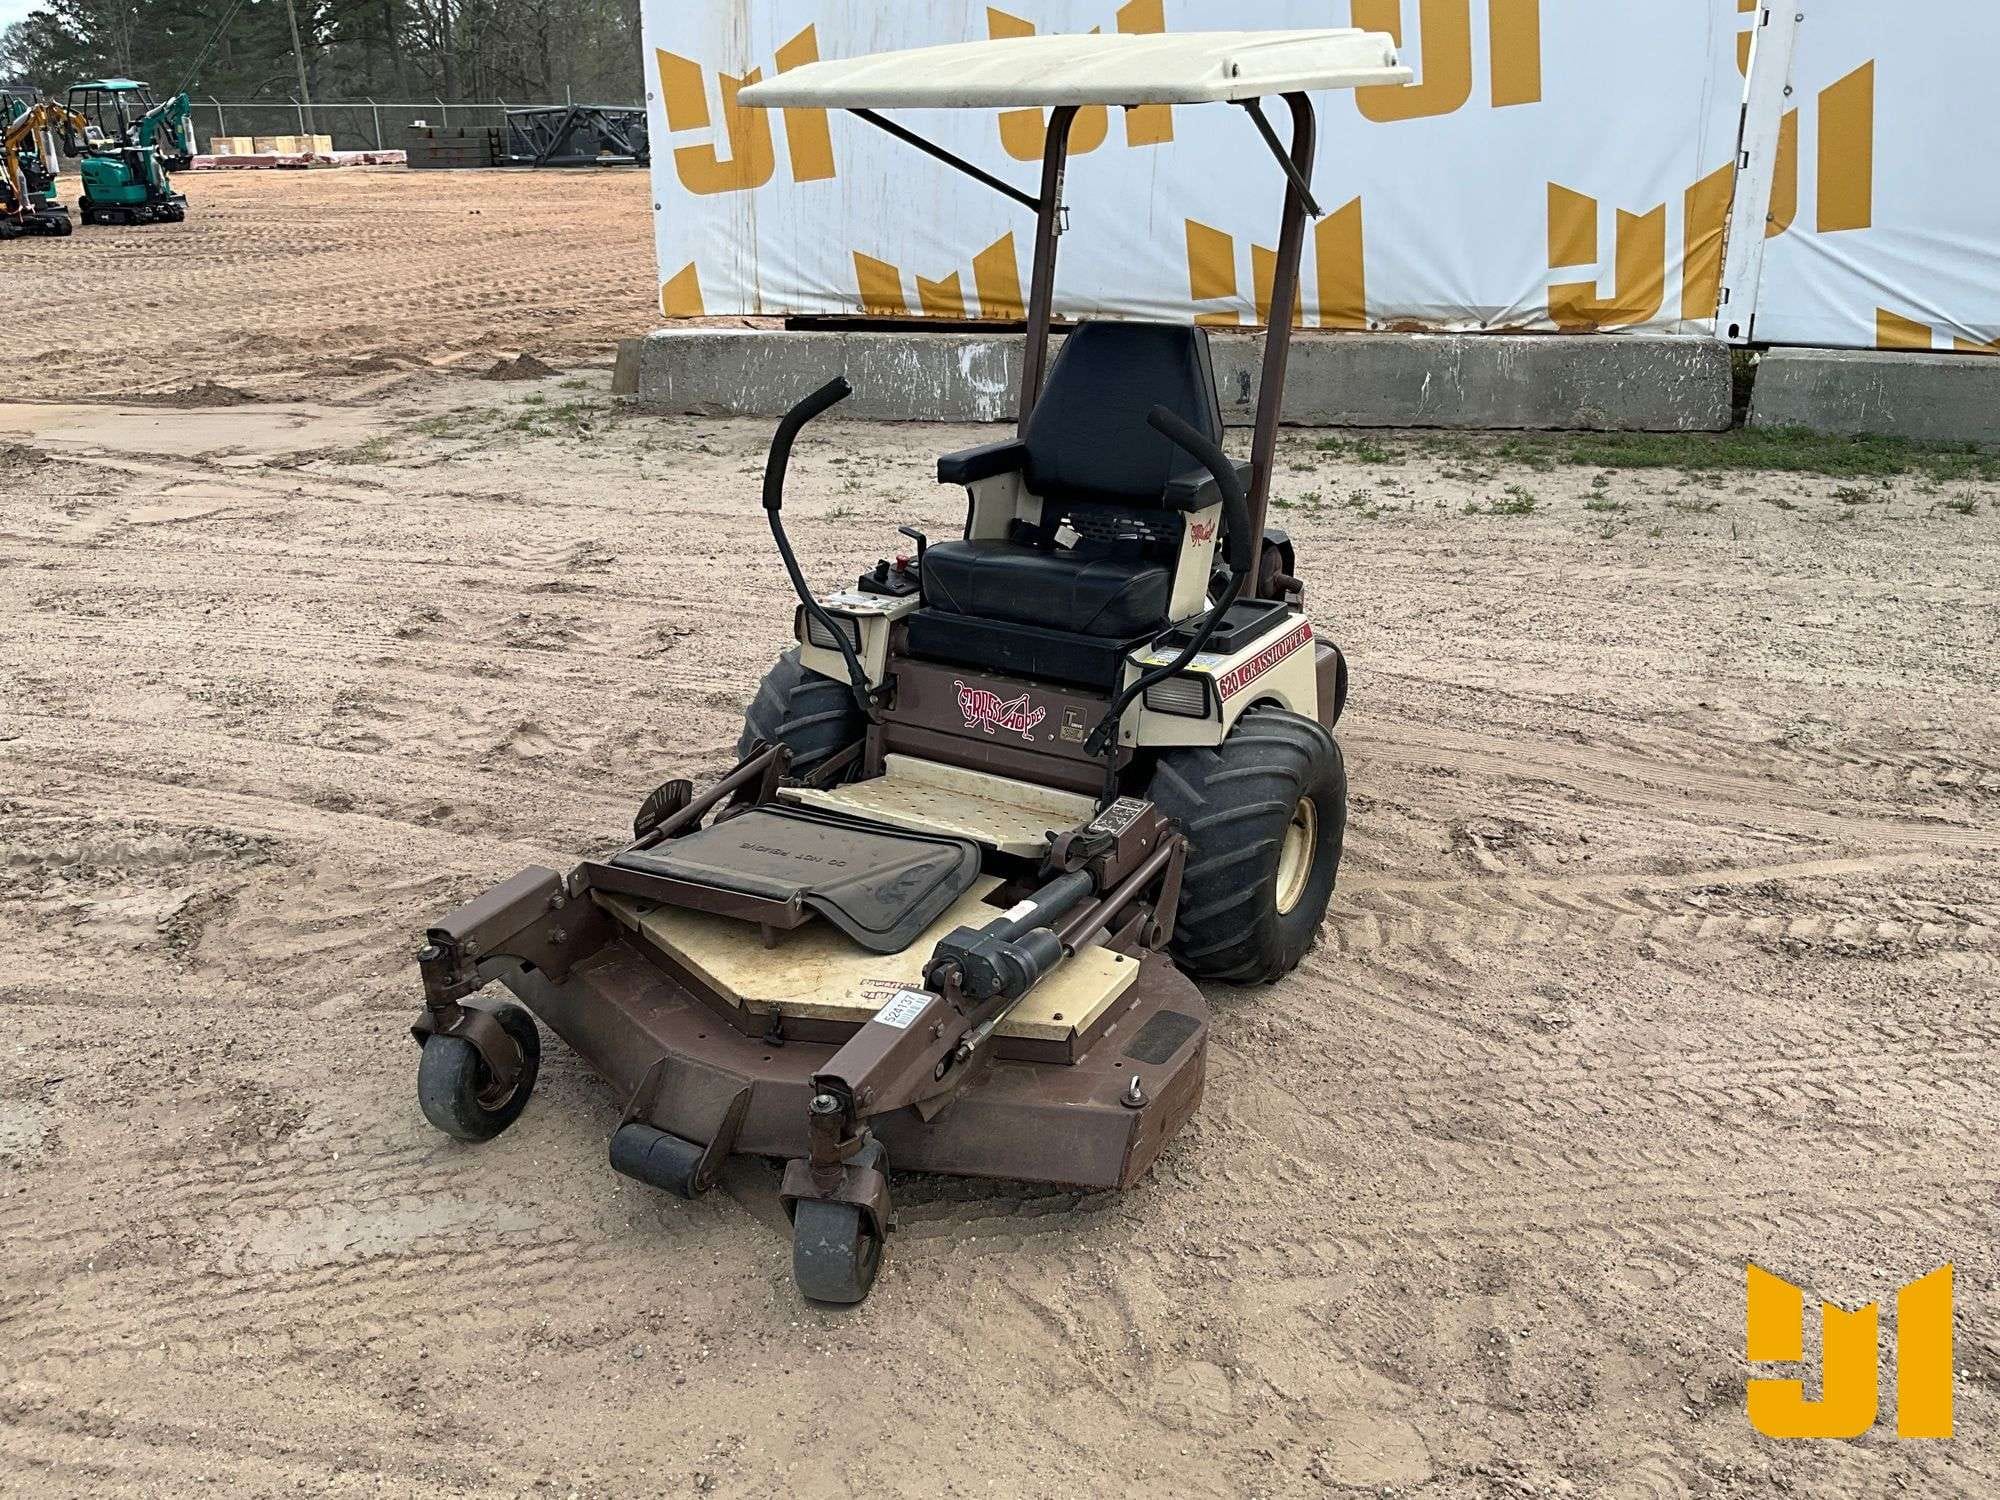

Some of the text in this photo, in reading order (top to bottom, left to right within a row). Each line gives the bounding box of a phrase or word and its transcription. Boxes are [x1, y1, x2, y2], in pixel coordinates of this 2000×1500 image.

[1219, 671, 1239, 699] 620
[1242, 627, 1306, 682] GRASSHOPPER
[794, 854, 824, 864] NOT
[885, 994, 916, 1023] 524137
